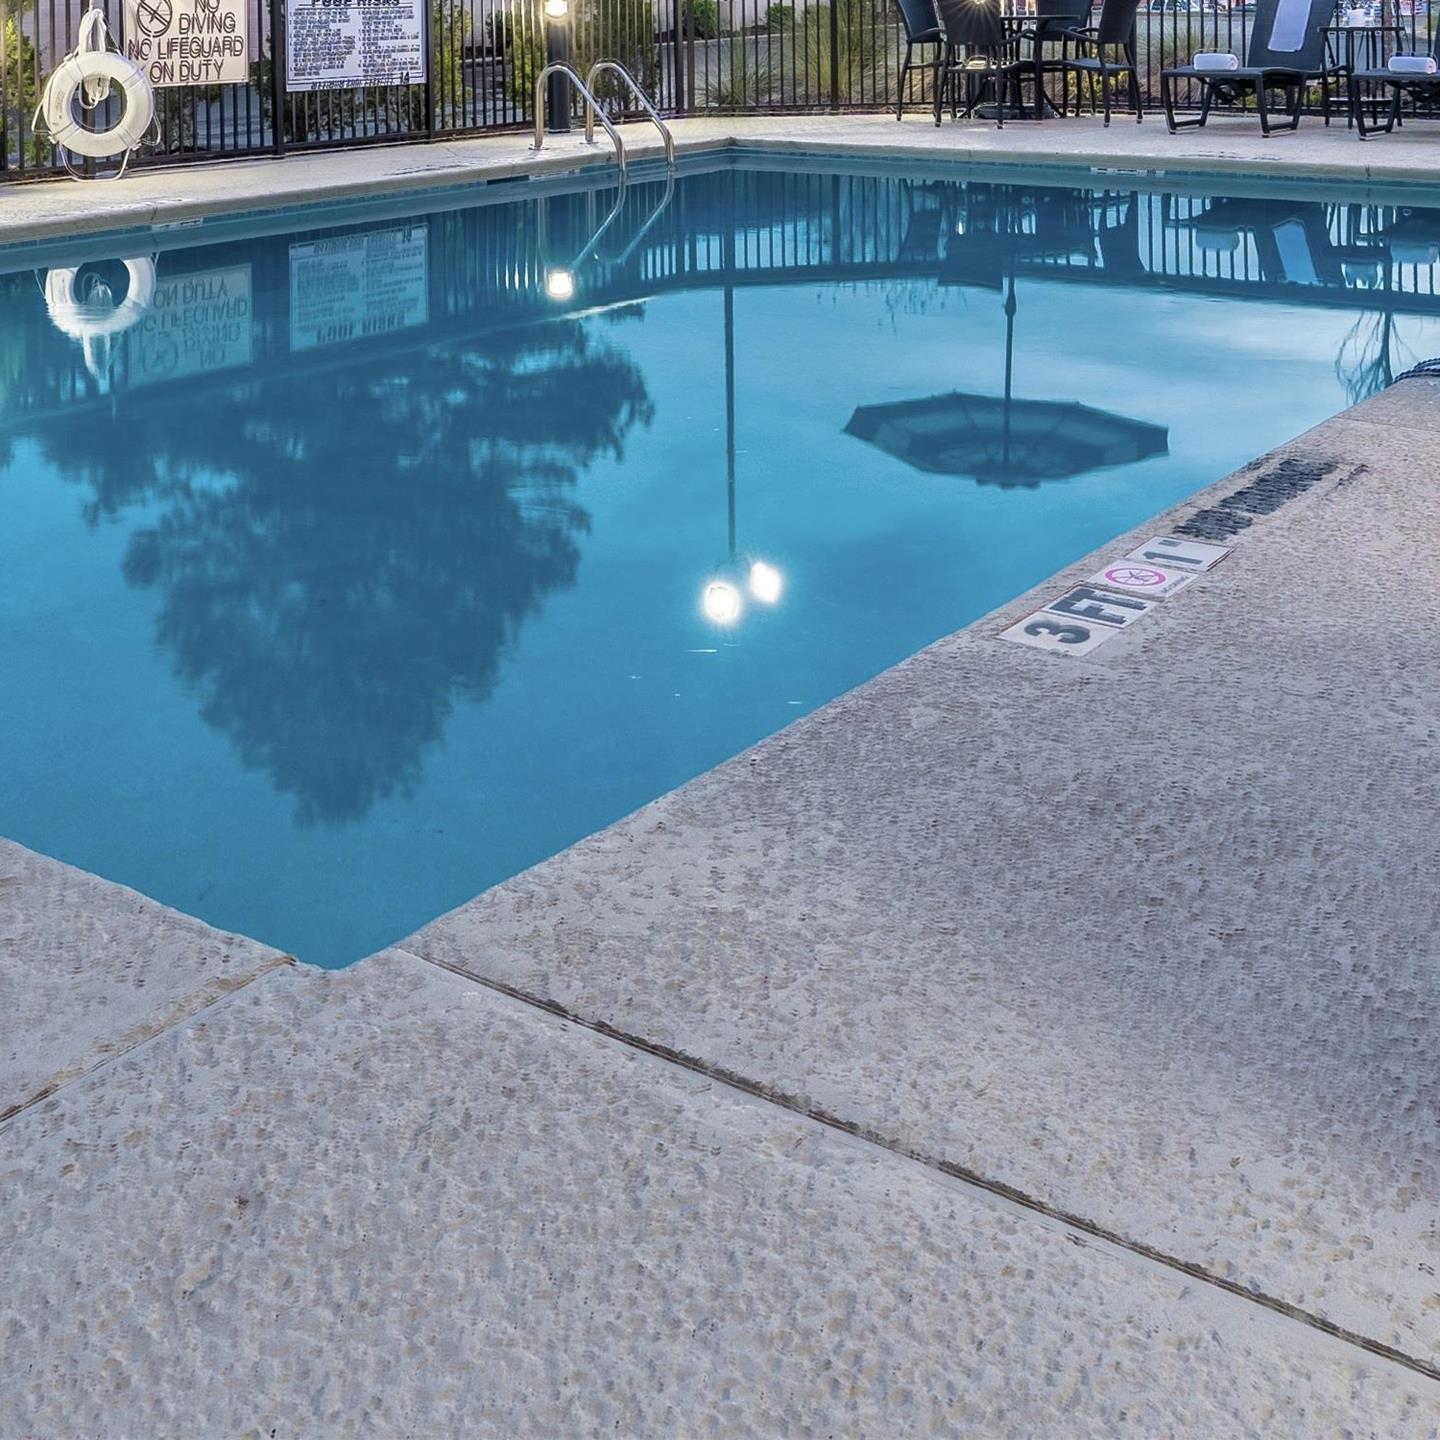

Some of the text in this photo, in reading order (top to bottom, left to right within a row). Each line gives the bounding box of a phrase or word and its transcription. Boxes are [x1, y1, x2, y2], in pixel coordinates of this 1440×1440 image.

[179, 12, 235, 34] DIVING
[128, 36, 244, 61] NO LIFEGUARD
[150, 59, 224, 83] ON DUTY
[1023, 584, 1148, 645] 3 FT
